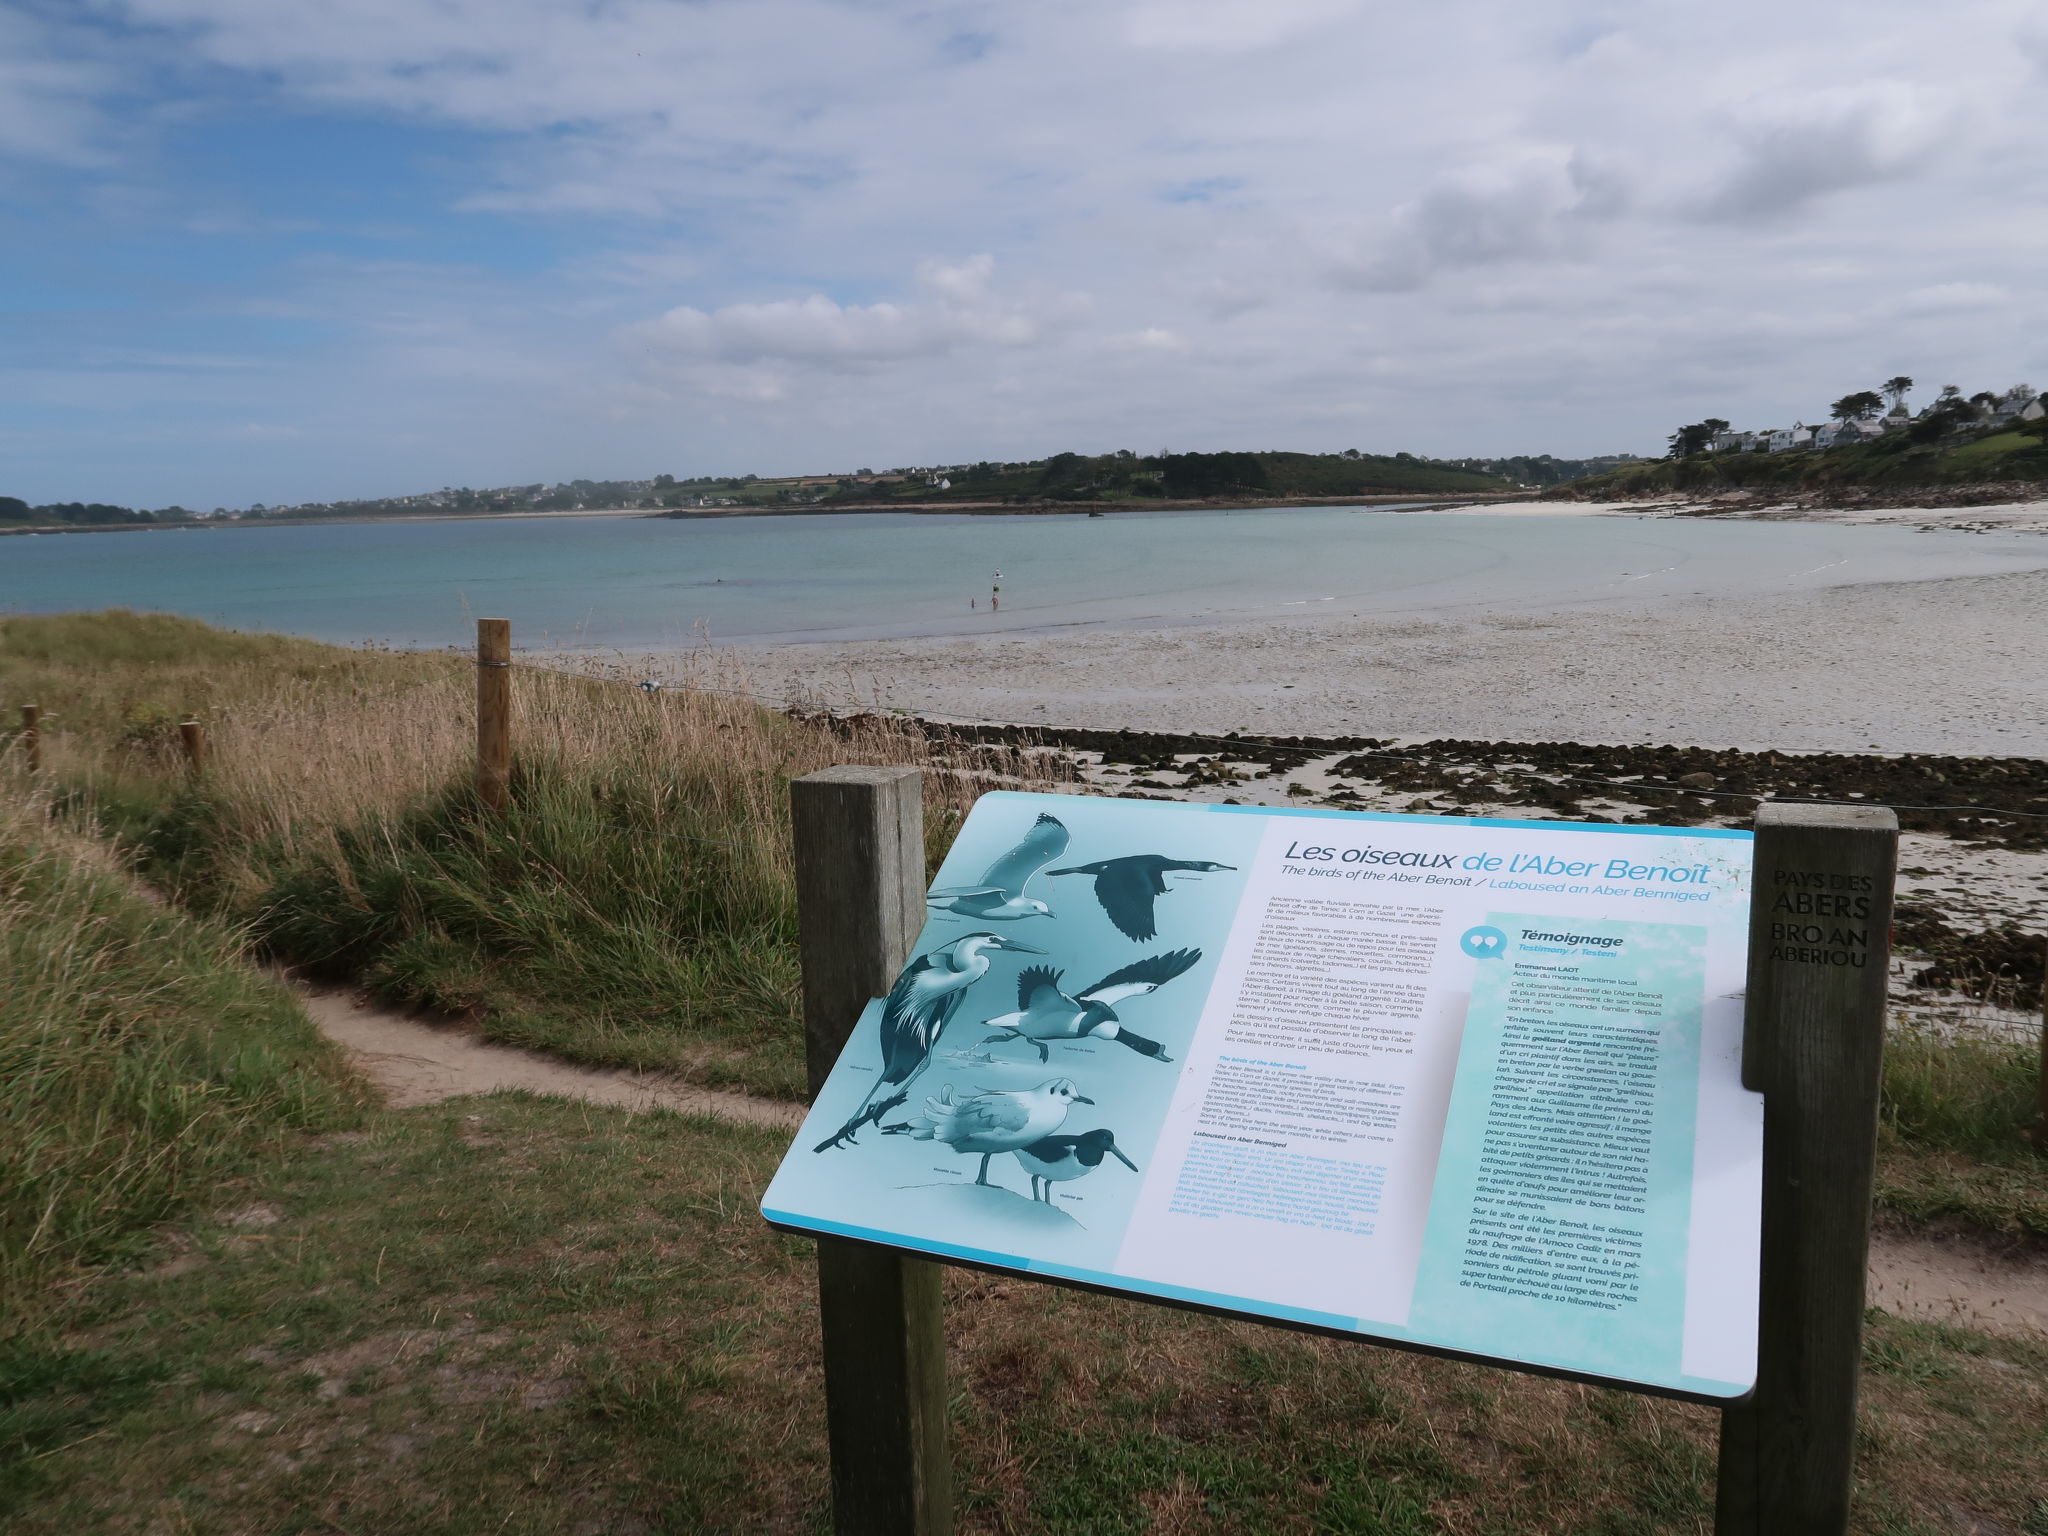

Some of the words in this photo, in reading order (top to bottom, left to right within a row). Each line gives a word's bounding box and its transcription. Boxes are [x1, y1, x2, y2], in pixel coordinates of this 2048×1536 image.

[1285, 841, 1336, 861] Les
[1341, 846, 1457, 868] oiseaux
[1462, 852, 1502, 871] de
[1509, 854, 1598, 876] l'Aber
[1604, 859, 1711, 883] Benoît
[1281, 864, 1306, 875] The
[1307, 866, 1342, 877] birds
[1345, 869, 1363, 880] of
[1362, 870, 1385, 880] the
[1387, 872, 1423, 882] Aber
[1489, 879, 1566, 892] Laboused
[1568, 885, 1589, 893] an
[1591, 885, 1629, 896] Aber
[1633, 887, 1710, 902] Benniged
[1774, 871, 1825, 889] PAYS
[1830, 874, 1873, 892] DES
[1771, 891, 1871, 920] ABERS
[1522, 929, 1622, 947] Témoignage
[1771, 923, 1823, 944] BRO
[1828, 928, 1868, 948] AN
[1518, 943, 1568, 955] Testimony
[1581, 946, 1617, 957] Testeni
[1769, 946, 1867, 968] ABERIOU
[1514, 962, 1556, 971] Emmanuel
[1193, 1130, 1227, 1139] Laboused
[1253, 1138, 1287, 1148] Benniged
[1489, 1174, 1514, 1185] quête
[1515, 1180, 1545, 1190] d'œufs
[1569, 1188, 1611, 1198] améliorer
[1613, 1193, 1631, 1201] leur
[1492, 1168, 1542, 1179] goémoniers
[1603, 1183, 1647, 1193] mettaient
[1473, 1195, 1495, 1203] pour
[1475, 1185, 1505, 1194] dinaire
[1519, 1192, 1572, 1204] munissaient
[1589, 1200, 1610, 1208] bons
[1613, 1203, 1645, 1213] bâtons
[1469, 1217, 1506, 1228] présents
[1526, 1225, 1540, 1233] été
[1542, 1227, 1555, 1235] les
[1557, 1231, 1602, 1242] premières
[1605, 1236, 1642, 1247] victimes
[1517, 1213, 1529, 1221] de
[1531, 1215, 1557, 1224] l'Aber
[1592, 1223, 1605, 1231] les
[1608, 1226, 1642, 1236] oiseaux
[1482, 1230, 1522, 1241] naufrage
[1524, 1235, 1536, 1243] de
[1538, 1237, 1573, 1248] l'Amoco
[1576, 1242, 1602, 1252] Cadiz
[1617, 1250, 1641, 1258] mars
[1491, 1240, 1508, 1249] Des
[1511, 1244, 1543, 1254] milliers
[1546, 1249, 1577, 1259] d'entre
[1611, 1258, 1621, 1266] la
[1623, 1261, 1640, 1269] pé-
[1463, 1259, 1499, 1269] sonniers
[1502, 1264, 1514, 1272] du
[1516, 1267, 1549, 1277] pétrole
[1551, 1272, 1582, 1282] gluant
[1585, 1278, 1608, 1286] vomi
[1609, 1281, 1627, 1289] par
[1629, 1283, 1639, 1291] le
[1464, 1247, 1487, 1257] riode
[1488, 1251, 1500, 1259] de
[1566, 1264, 1586, 1272] sont
[1587, 1266, 1621, 1277] trouvés
[1459, 1279, 1471, 1287] de
[1472, 1281, 1507, 1292] Portsall
[1507, 1288, 1539, 1298] proche
[1540, 1292, 1553, 1300] de
[1567, 1295, 1621, 1310] kilomètres."
[1461, 1269, 1486, 1278] super
[1487, 1272, 1515, 1283] tanker
[1516, 1277, 1550, 1288] échoué
[1563, 1284, 1588, 1295] large
[1588, 1288, 1605, 1297] des
[1606, 1292, 1637, 1302] roches
